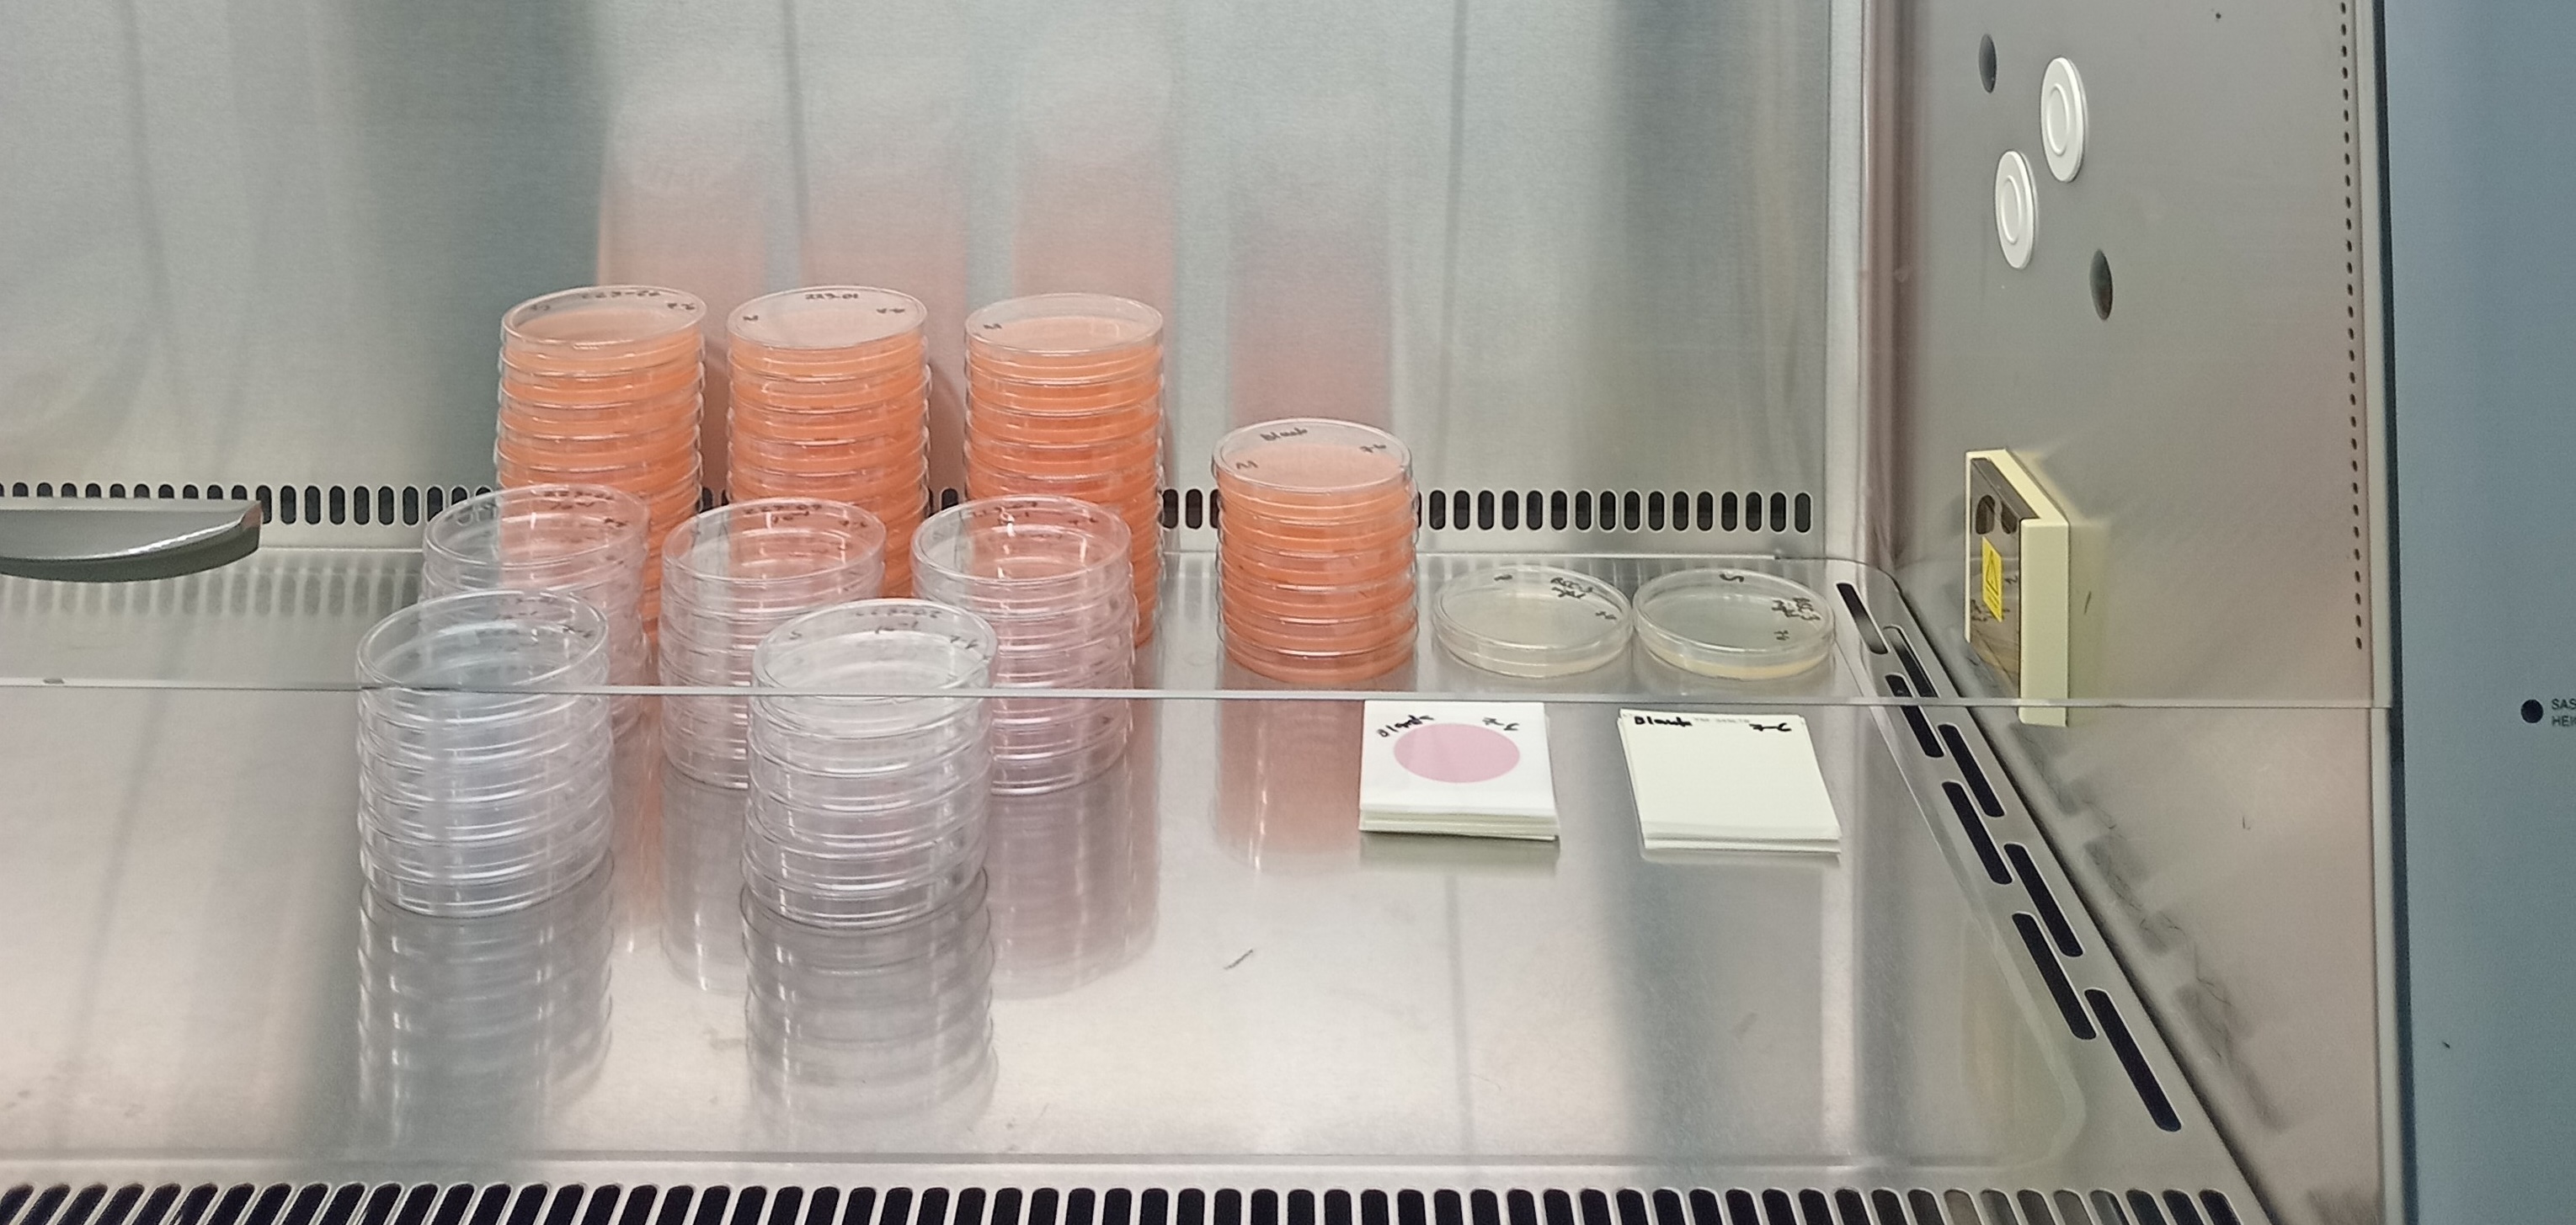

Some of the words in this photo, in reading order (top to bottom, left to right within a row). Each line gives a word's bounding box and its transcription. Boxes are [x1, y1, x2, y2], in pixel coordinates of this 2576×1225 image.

[2551, 698, 2576, 711] SAS
[1376, 713, 1435, 738] Blank
[1633, 715, 1692, 727] Blank
[2551, 715, 2576, 727] HEI
